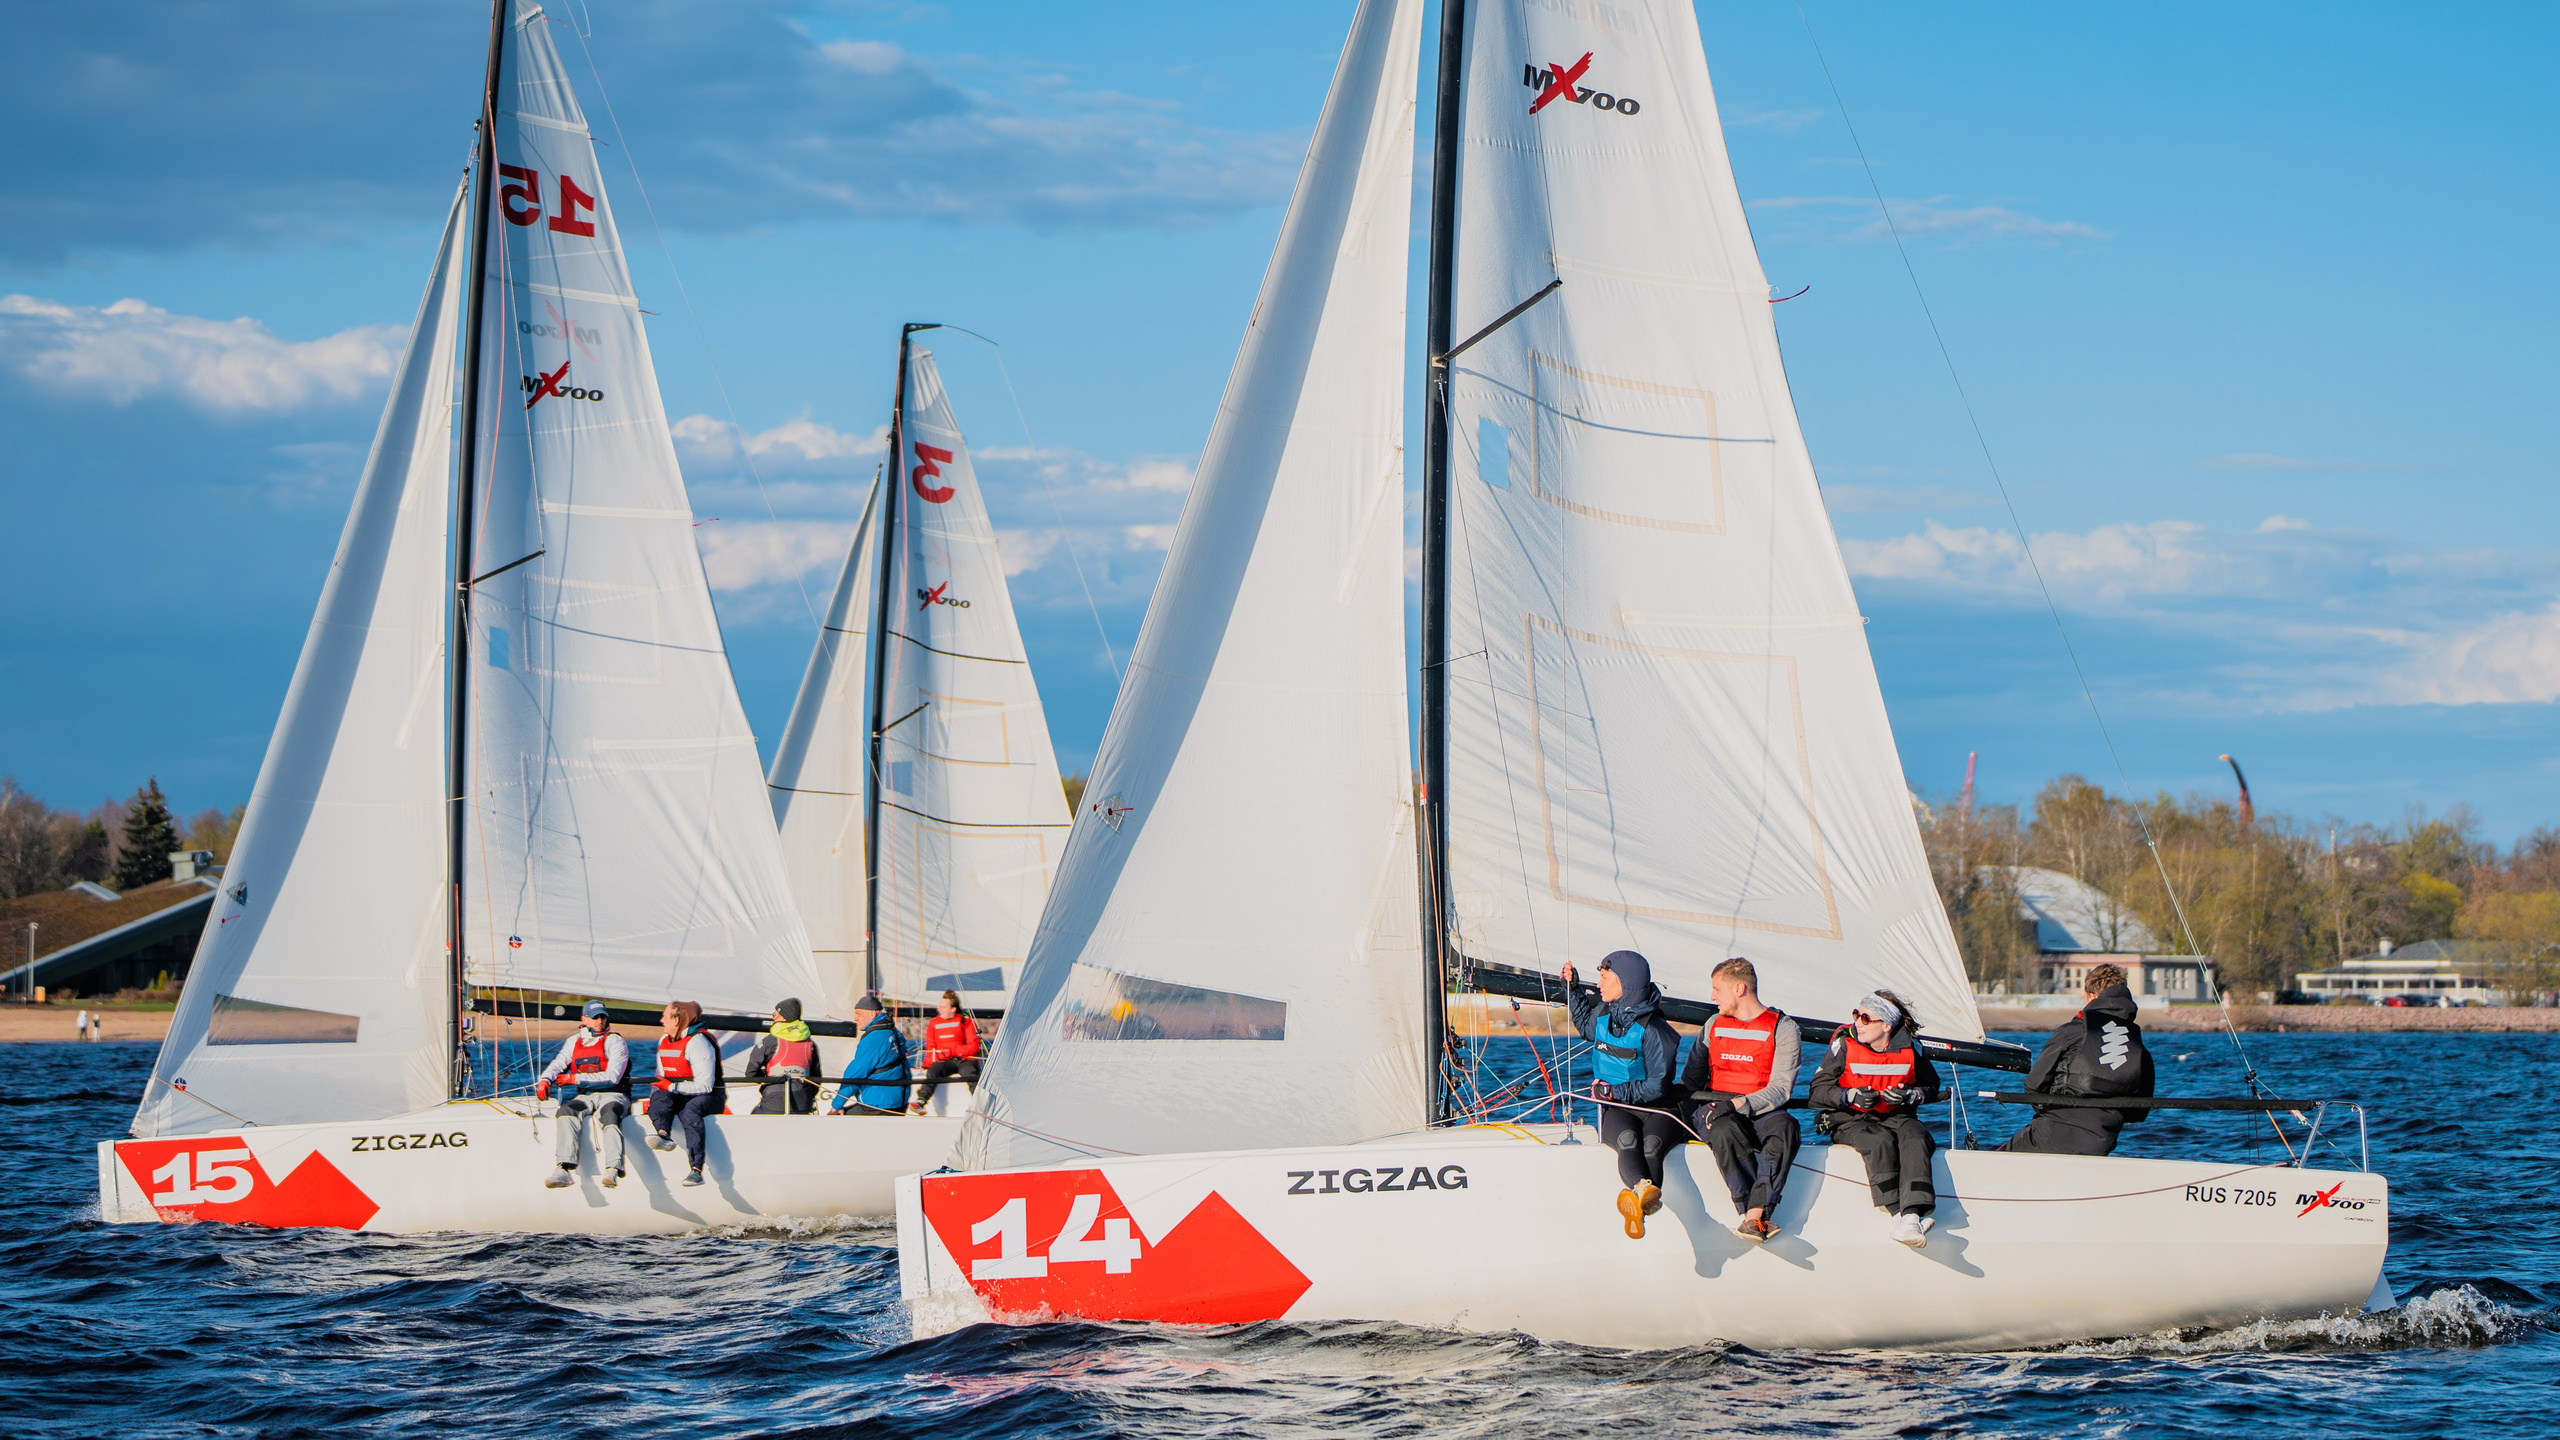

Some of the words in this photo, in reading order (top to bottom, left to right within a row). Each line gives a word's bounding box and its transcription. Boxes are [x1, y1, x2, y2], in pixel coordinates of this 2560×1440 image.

[1523, 51, 1640, 116] MX700
[520, 360, 604, 411] MX700
[917, 580, 971, 612] MX700
[1720, 1053, 1754, 1062] ZIGZAG
[351, 1131, 469, 1152] ZIGZAG
[152, 1147, 254, 1207] 15
[1287, 1164, 1469, 1195] ZIGZAG
[2185, 1185, 2227, 1204] RUS
[2234, 1188, 2277, 1207] 7205
[2295, 1180, 2365, 1219] MX700
[971, 1193, 1142, 1280] 14
